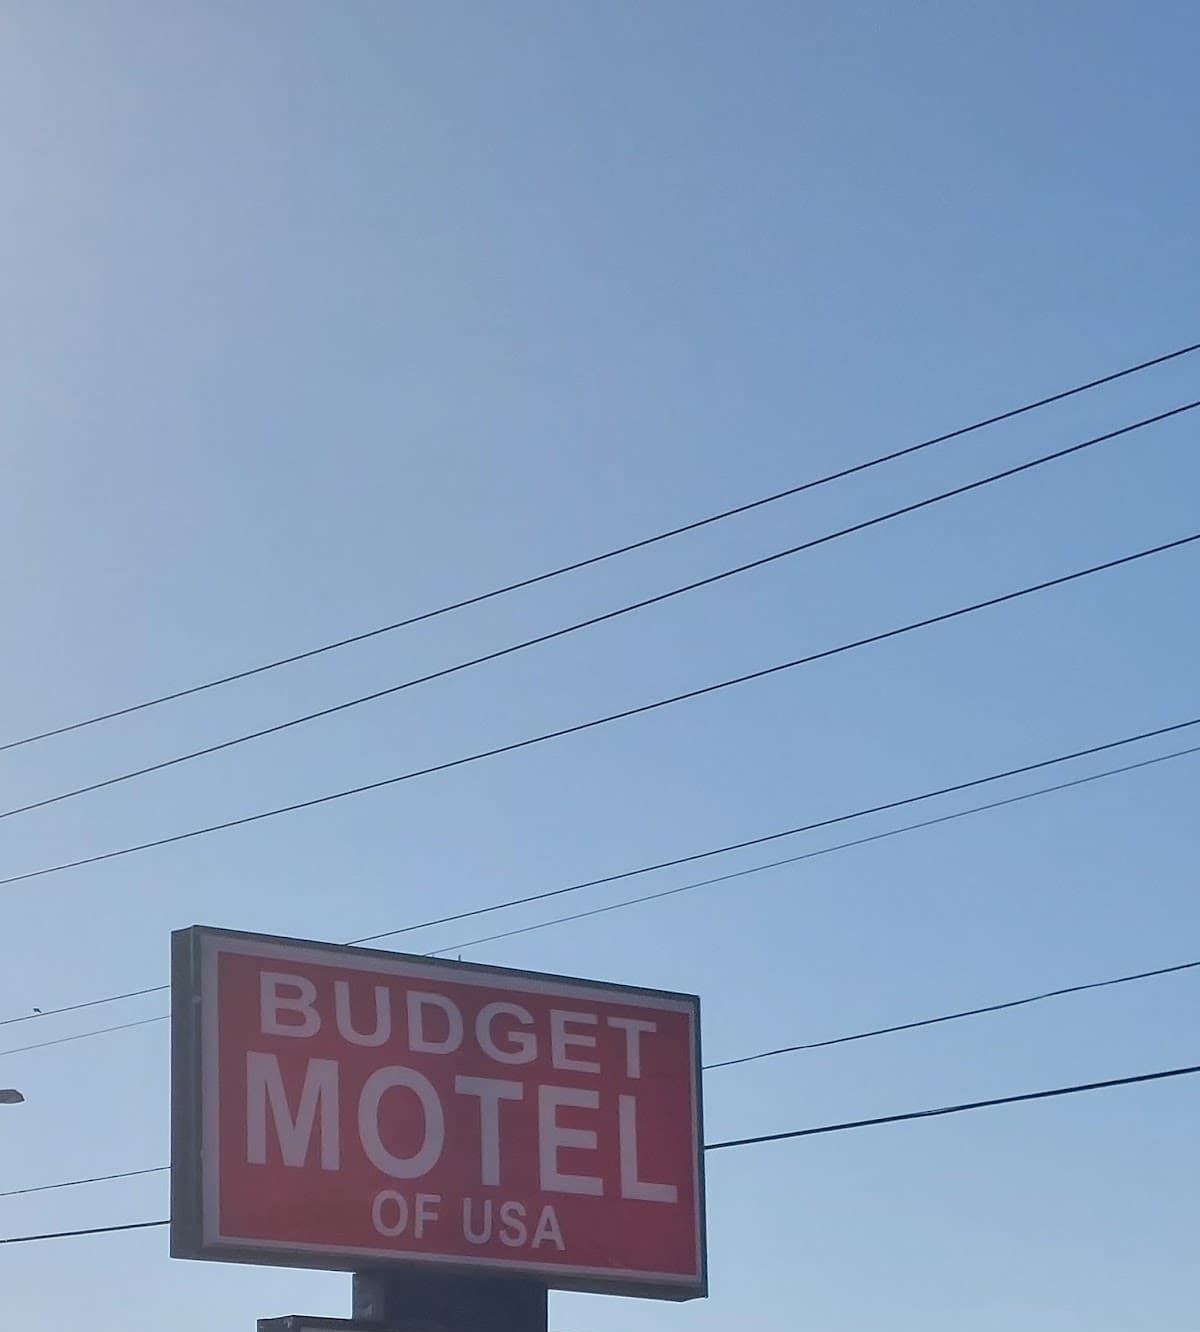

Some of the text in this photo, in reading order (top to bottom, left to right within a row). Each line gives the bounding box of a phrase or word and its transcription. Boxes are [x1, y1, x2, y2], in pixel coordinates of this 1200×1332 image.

[259, 971, 657, 1079] BUDGET
[245, 1051, 678, 1203] MOTEL
[372, 1189, 566, 1251] OF USA
